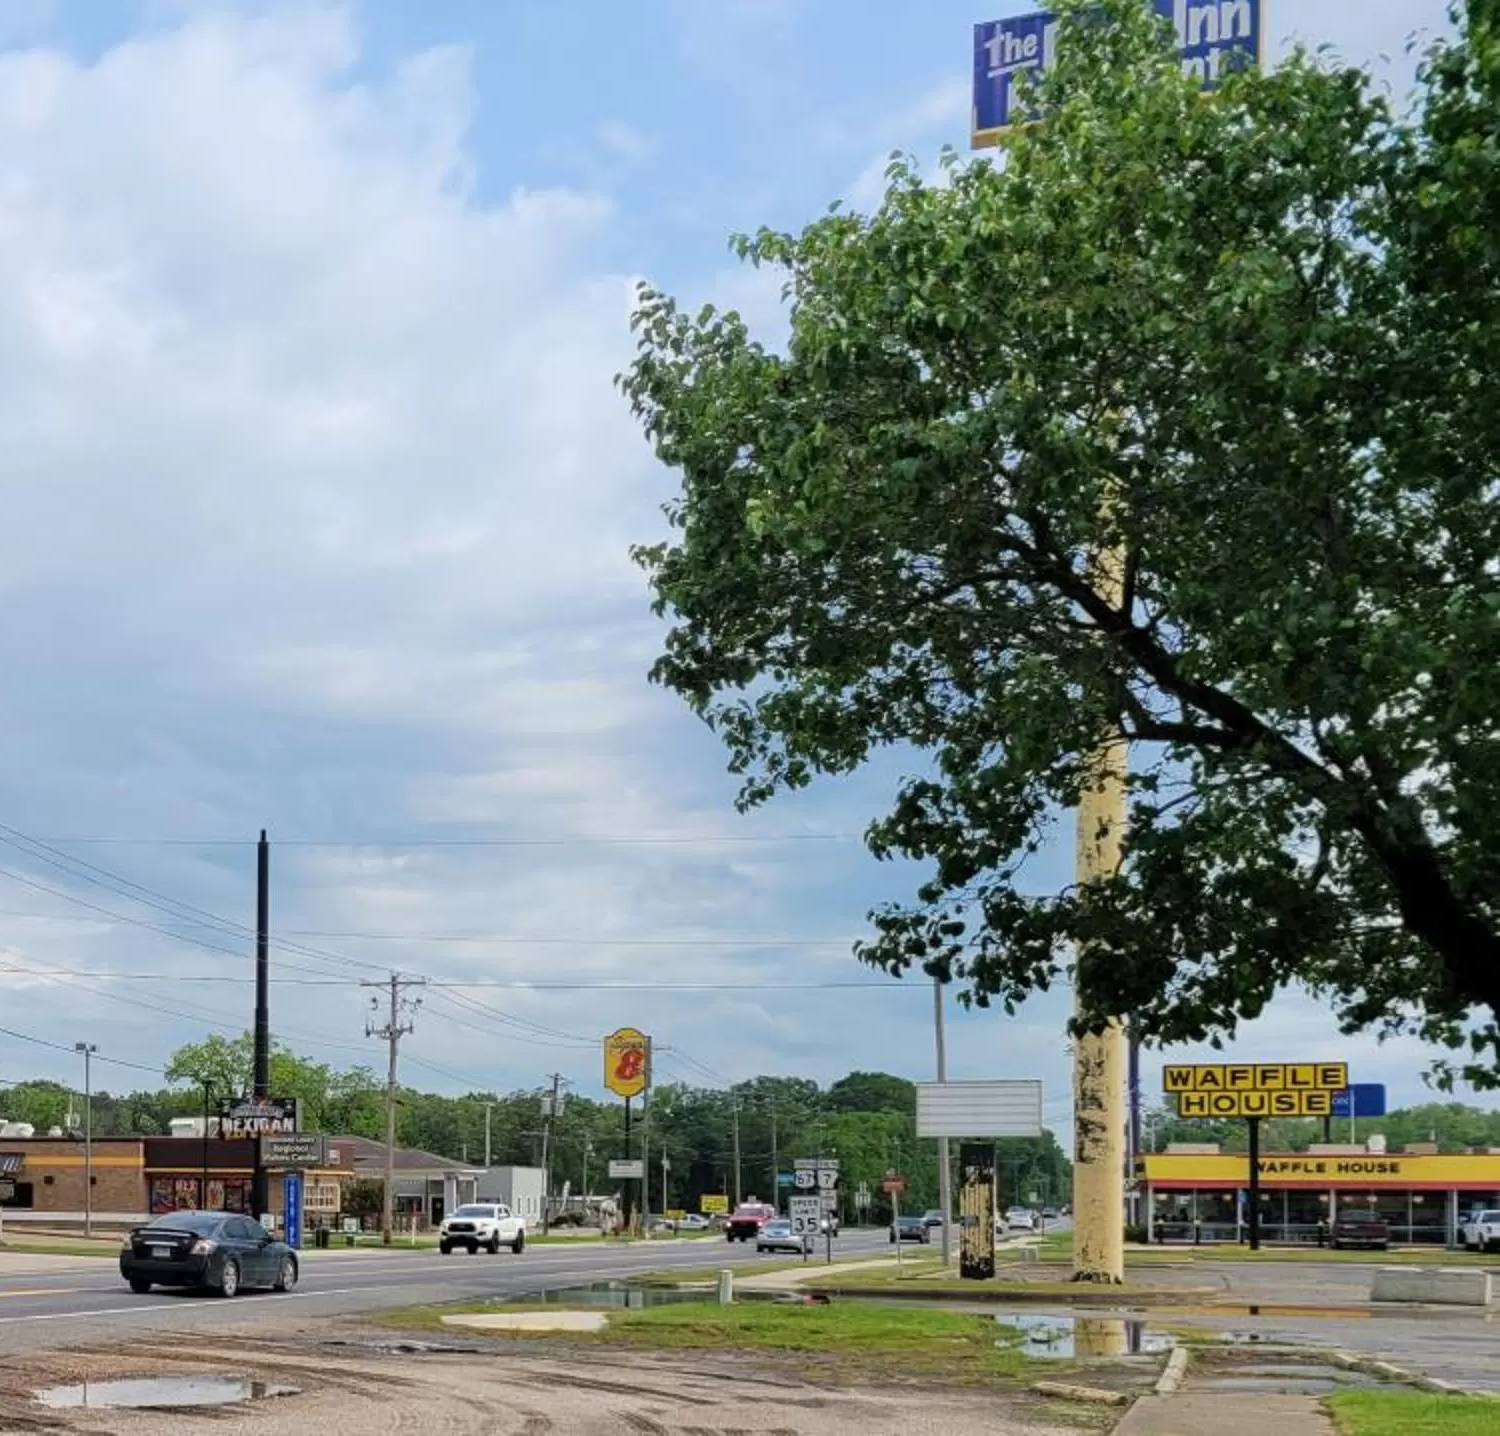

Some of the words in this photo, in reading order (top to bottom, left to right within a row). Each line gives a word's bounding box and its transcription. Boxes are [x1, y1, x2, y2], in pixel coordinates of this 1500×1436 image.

[1173, 0, 1251, 49] Inn
[1168, 1068, 1341, 1087] WAFFLE
[1184, 1094, 1326, 1113] HOUSE
[1337, 1162, 1400, 1173] HOUSE
[795, 1217, 818, 1233] 35
